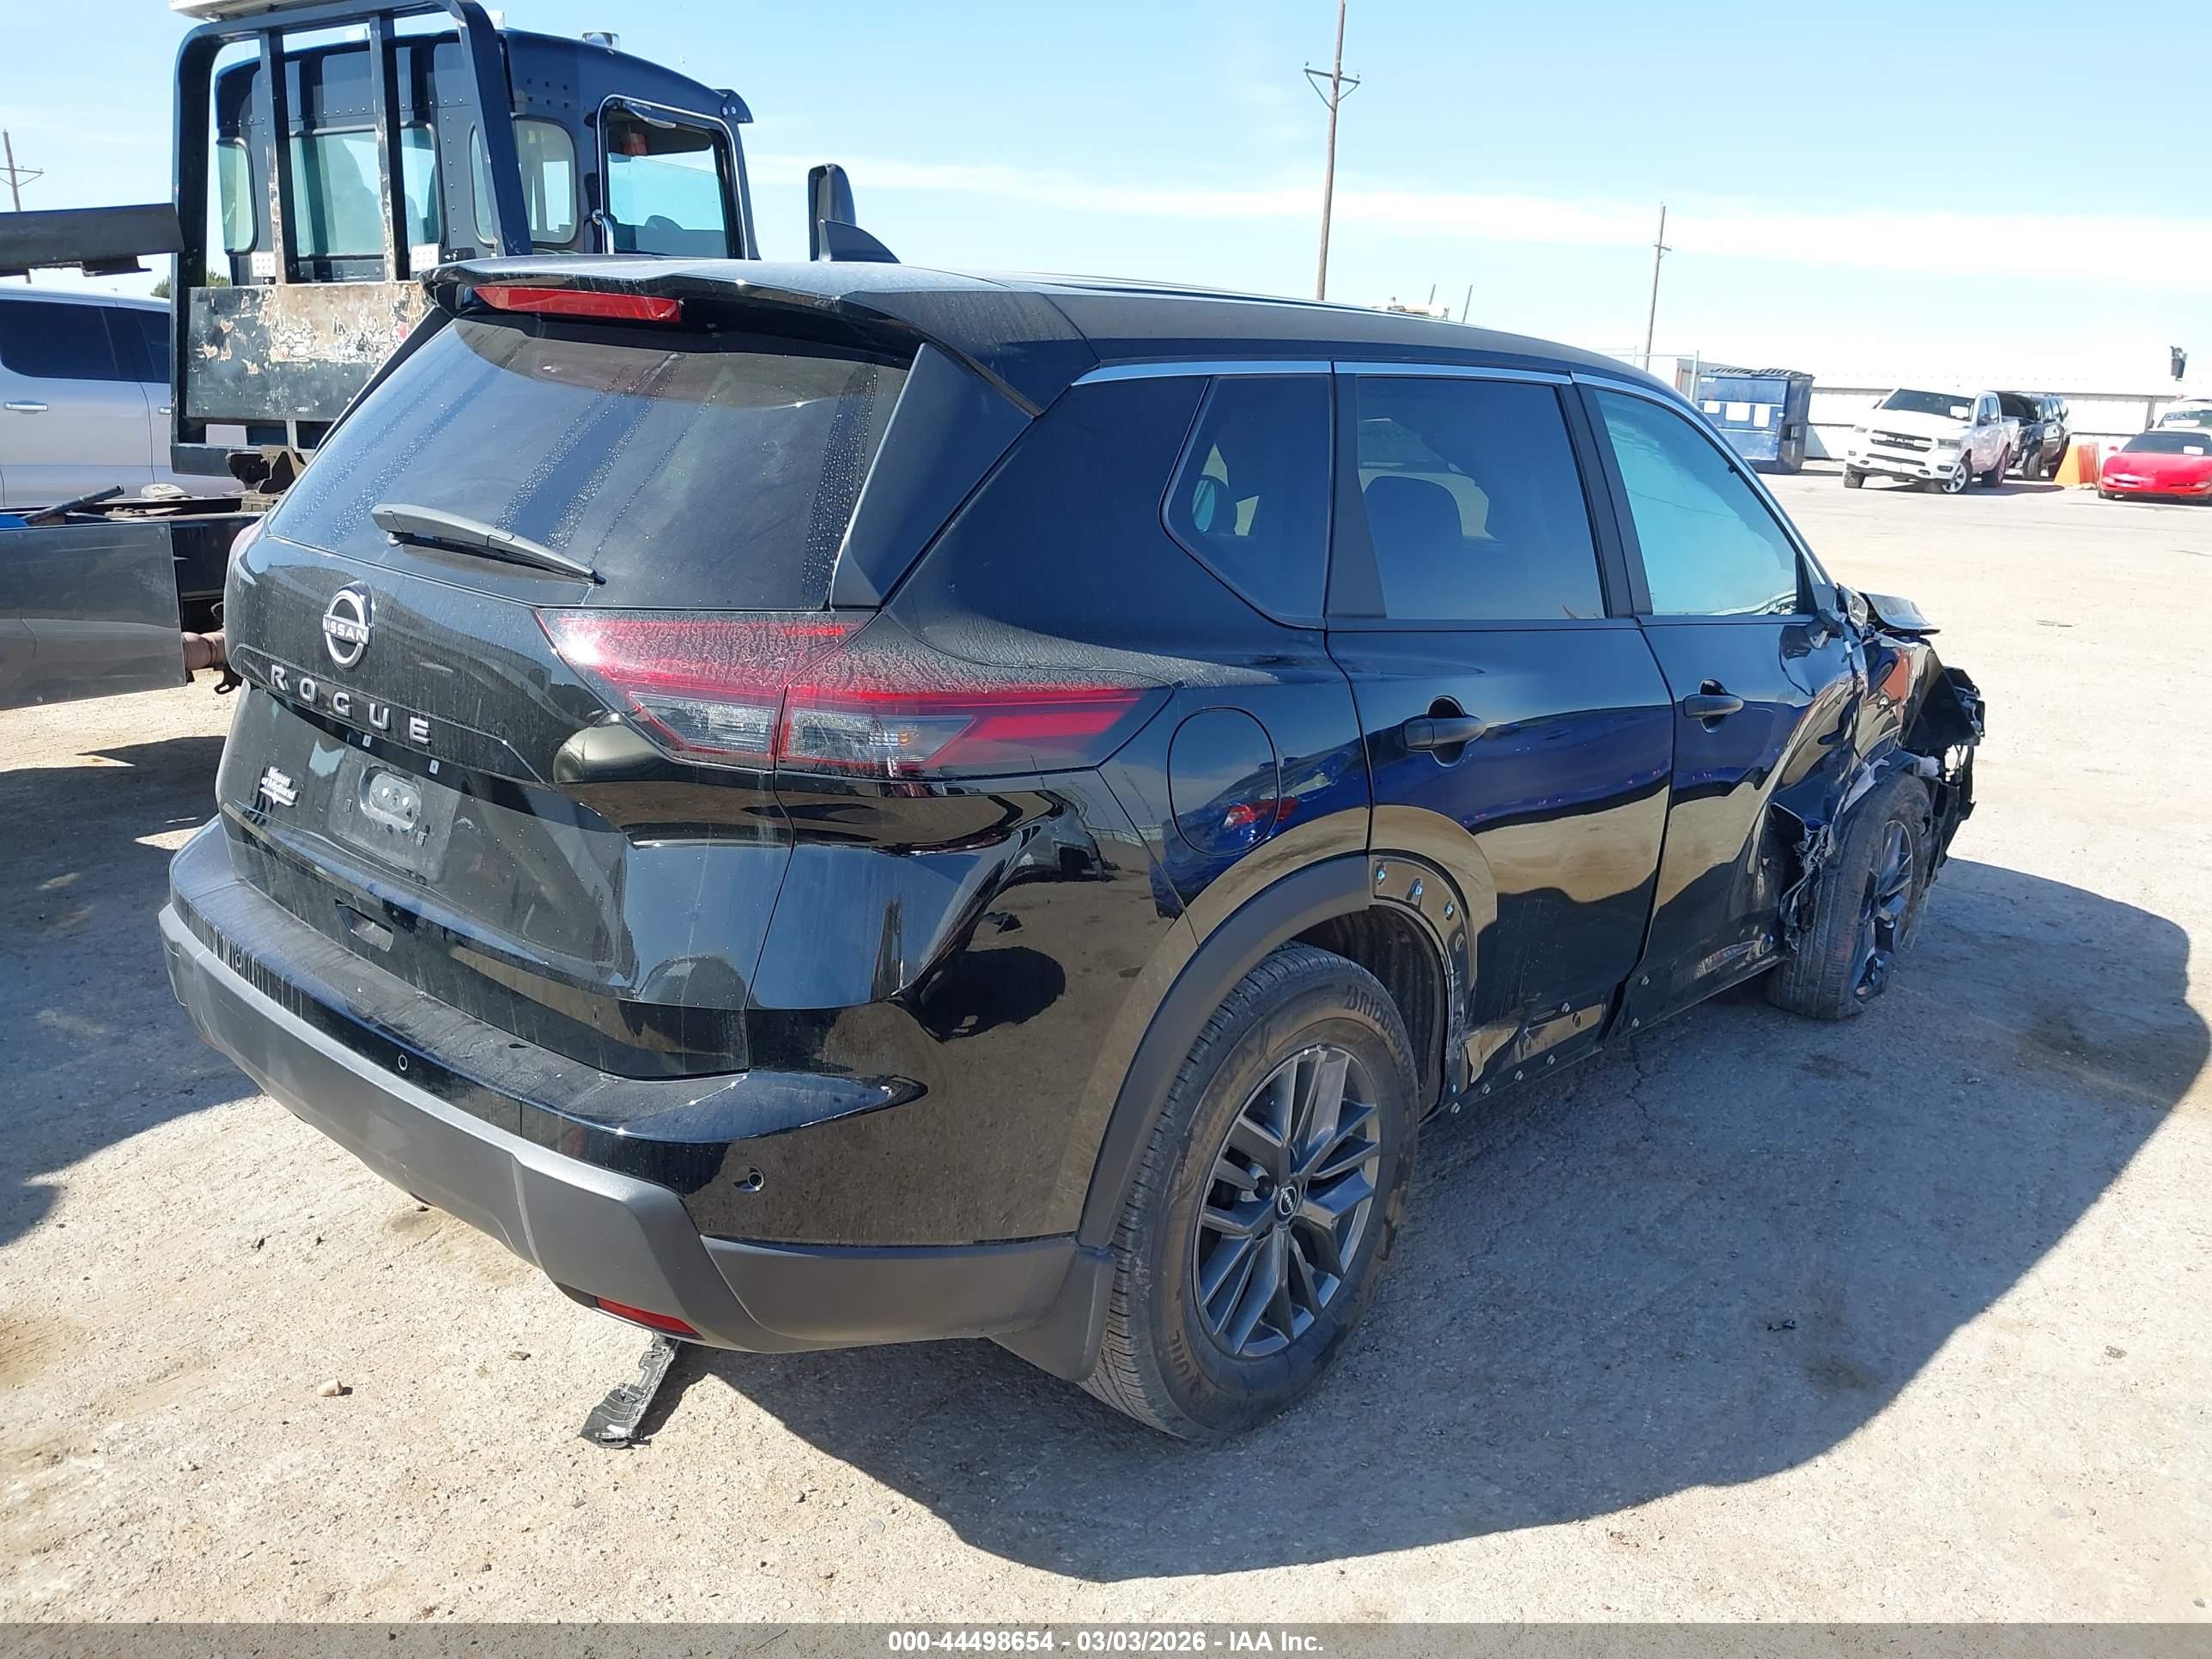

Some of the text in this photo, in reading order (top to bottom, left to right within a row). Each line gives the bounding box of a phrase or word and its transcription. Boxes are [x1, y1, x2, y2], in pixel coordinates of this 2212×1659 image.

[323, 616, 368, 643] NISSAN
[270, 665, 432, 745] ROGUE
[266, 778, 297, 801] Midland
[268, 766, 292, 788] Nissan
